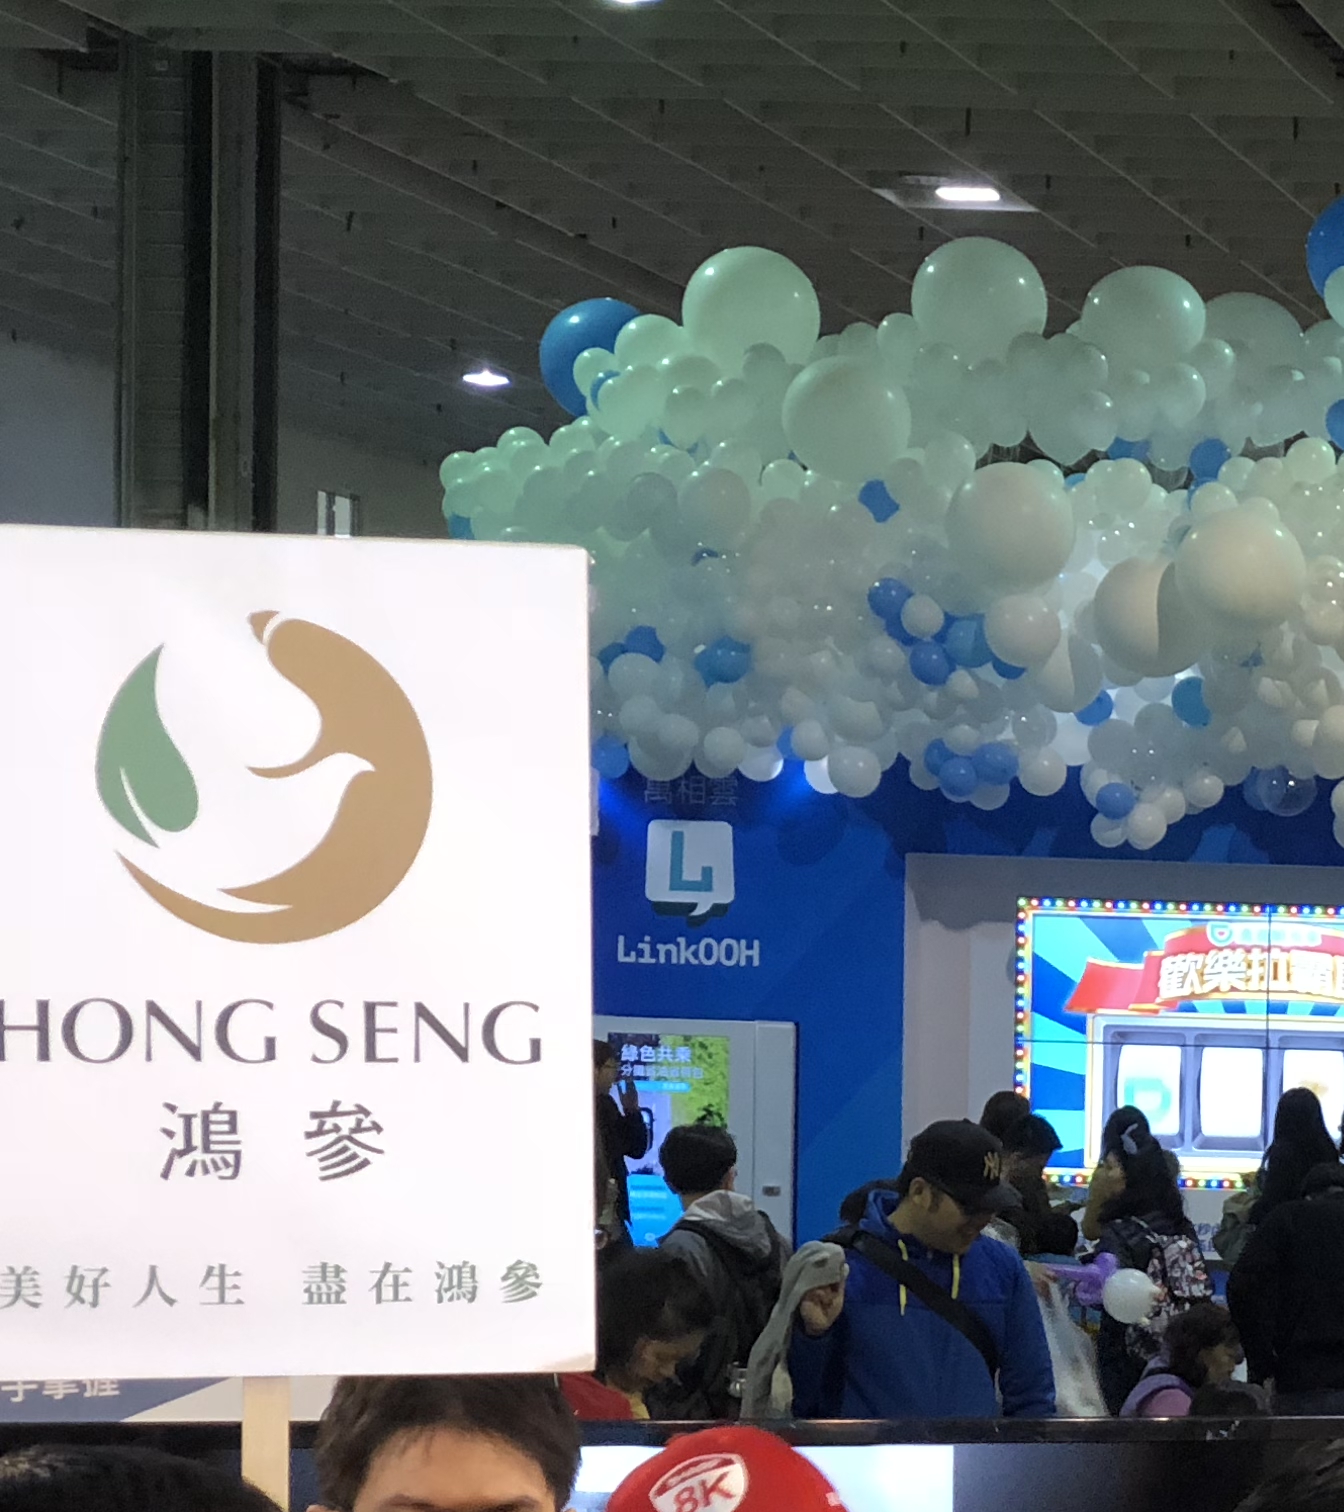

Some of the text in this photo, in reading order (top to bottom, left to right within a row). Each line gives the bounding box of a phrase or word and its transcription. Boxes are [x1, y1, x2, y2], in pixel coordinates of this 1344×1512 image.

[617, 934, 760, 967] LinkOOH
[0, 998, 544, 1067] HONG SENG
[159, 1100, 386, 1182] 鴻參
[301, 1260, 544, 1306] 盡在鴻參
